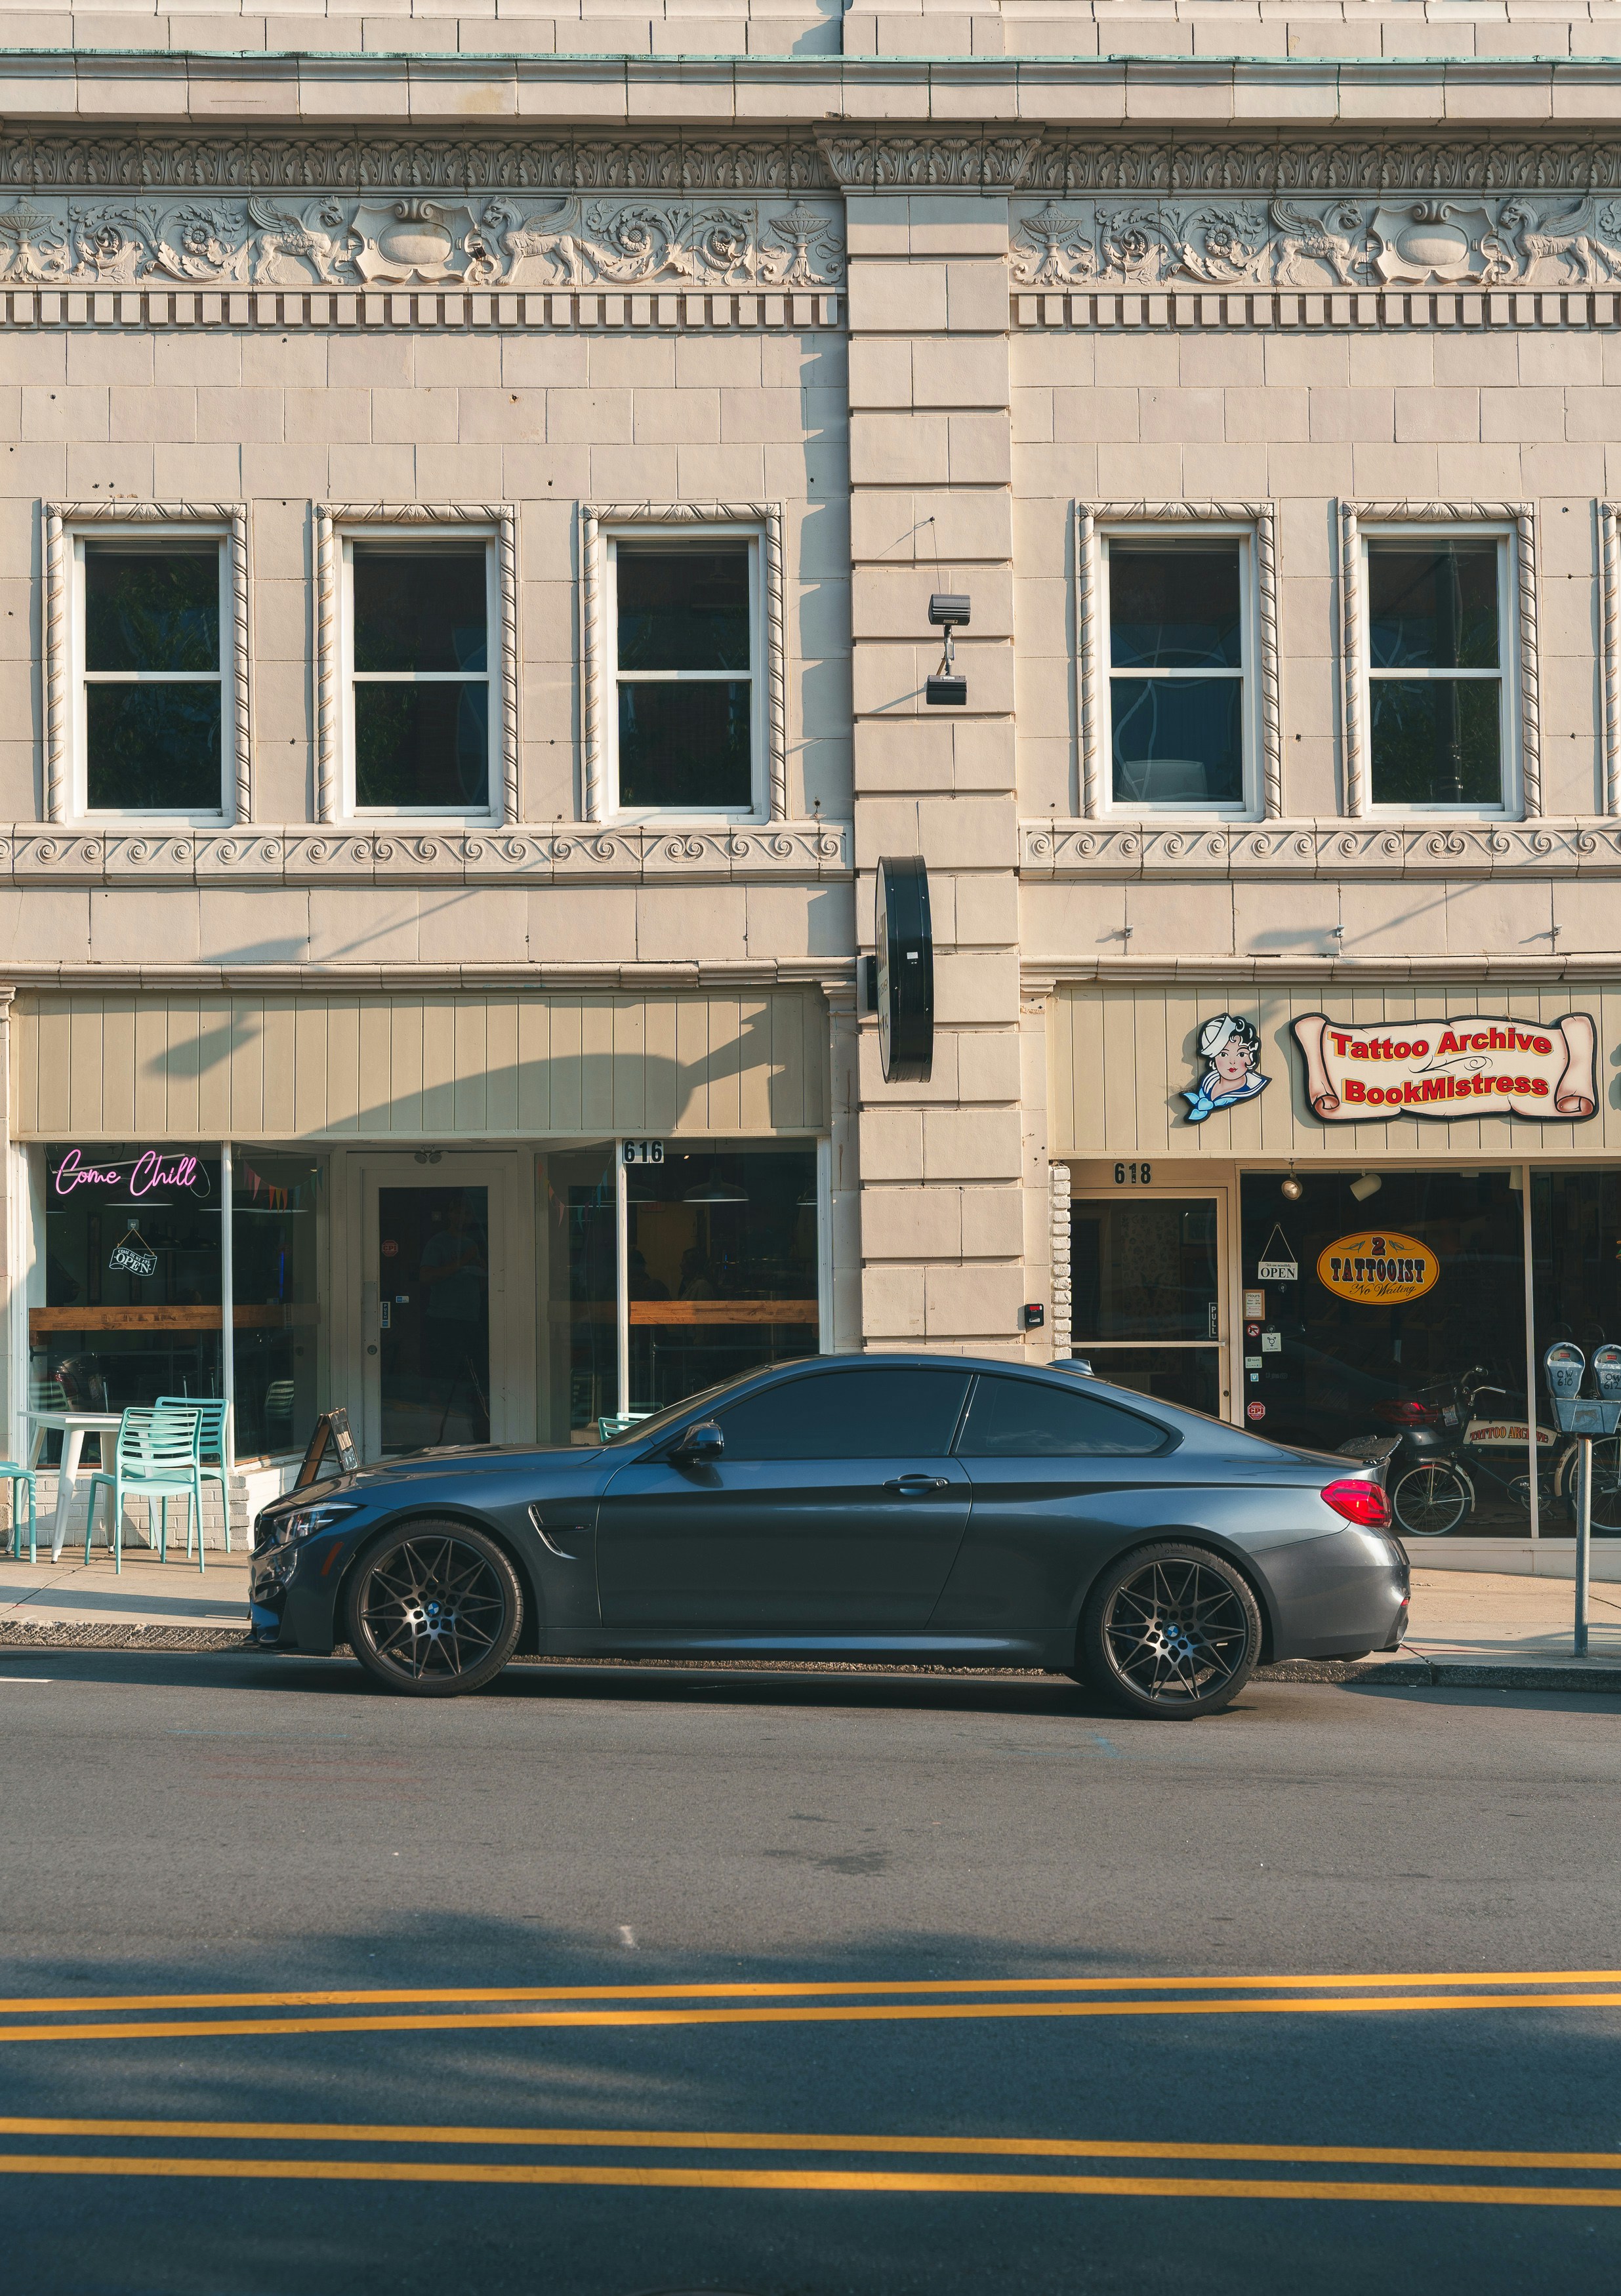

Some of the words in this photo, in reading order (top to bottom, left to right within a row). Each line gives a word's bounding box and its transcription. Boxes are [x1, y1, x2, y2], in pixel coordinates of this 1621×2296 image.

[1328, 1031, 1430, 1061] Tattoo
[1434, 1027, 1554, 1056] Archive
[1341, 1070, 1550, 1107] BookMistress
[624, 1140, 663, 1162] 616
[56, 1149, 121, 1195] Come
[130, 1150, 197, 1197] Chill
[1115, 1162, 1151, 1184] 618
[1371, 1236, 1386, 1256] 2
[115, 1253, 151, 1273] OPEN
[1260, 1267, 1296, 1278] OPEN
[1330, 1257, 1426, 1284] TATTOOIST
[1349, 1283, 1374, 1296] No
[1374, 1282, 1416, 1297] Waiting
[1469, 1426, 1507, 1441] TATTOO
[1507, 1426, 1549, 1443] ARCVE
[1246, 1617, 1257, 1664] MICHELIN
